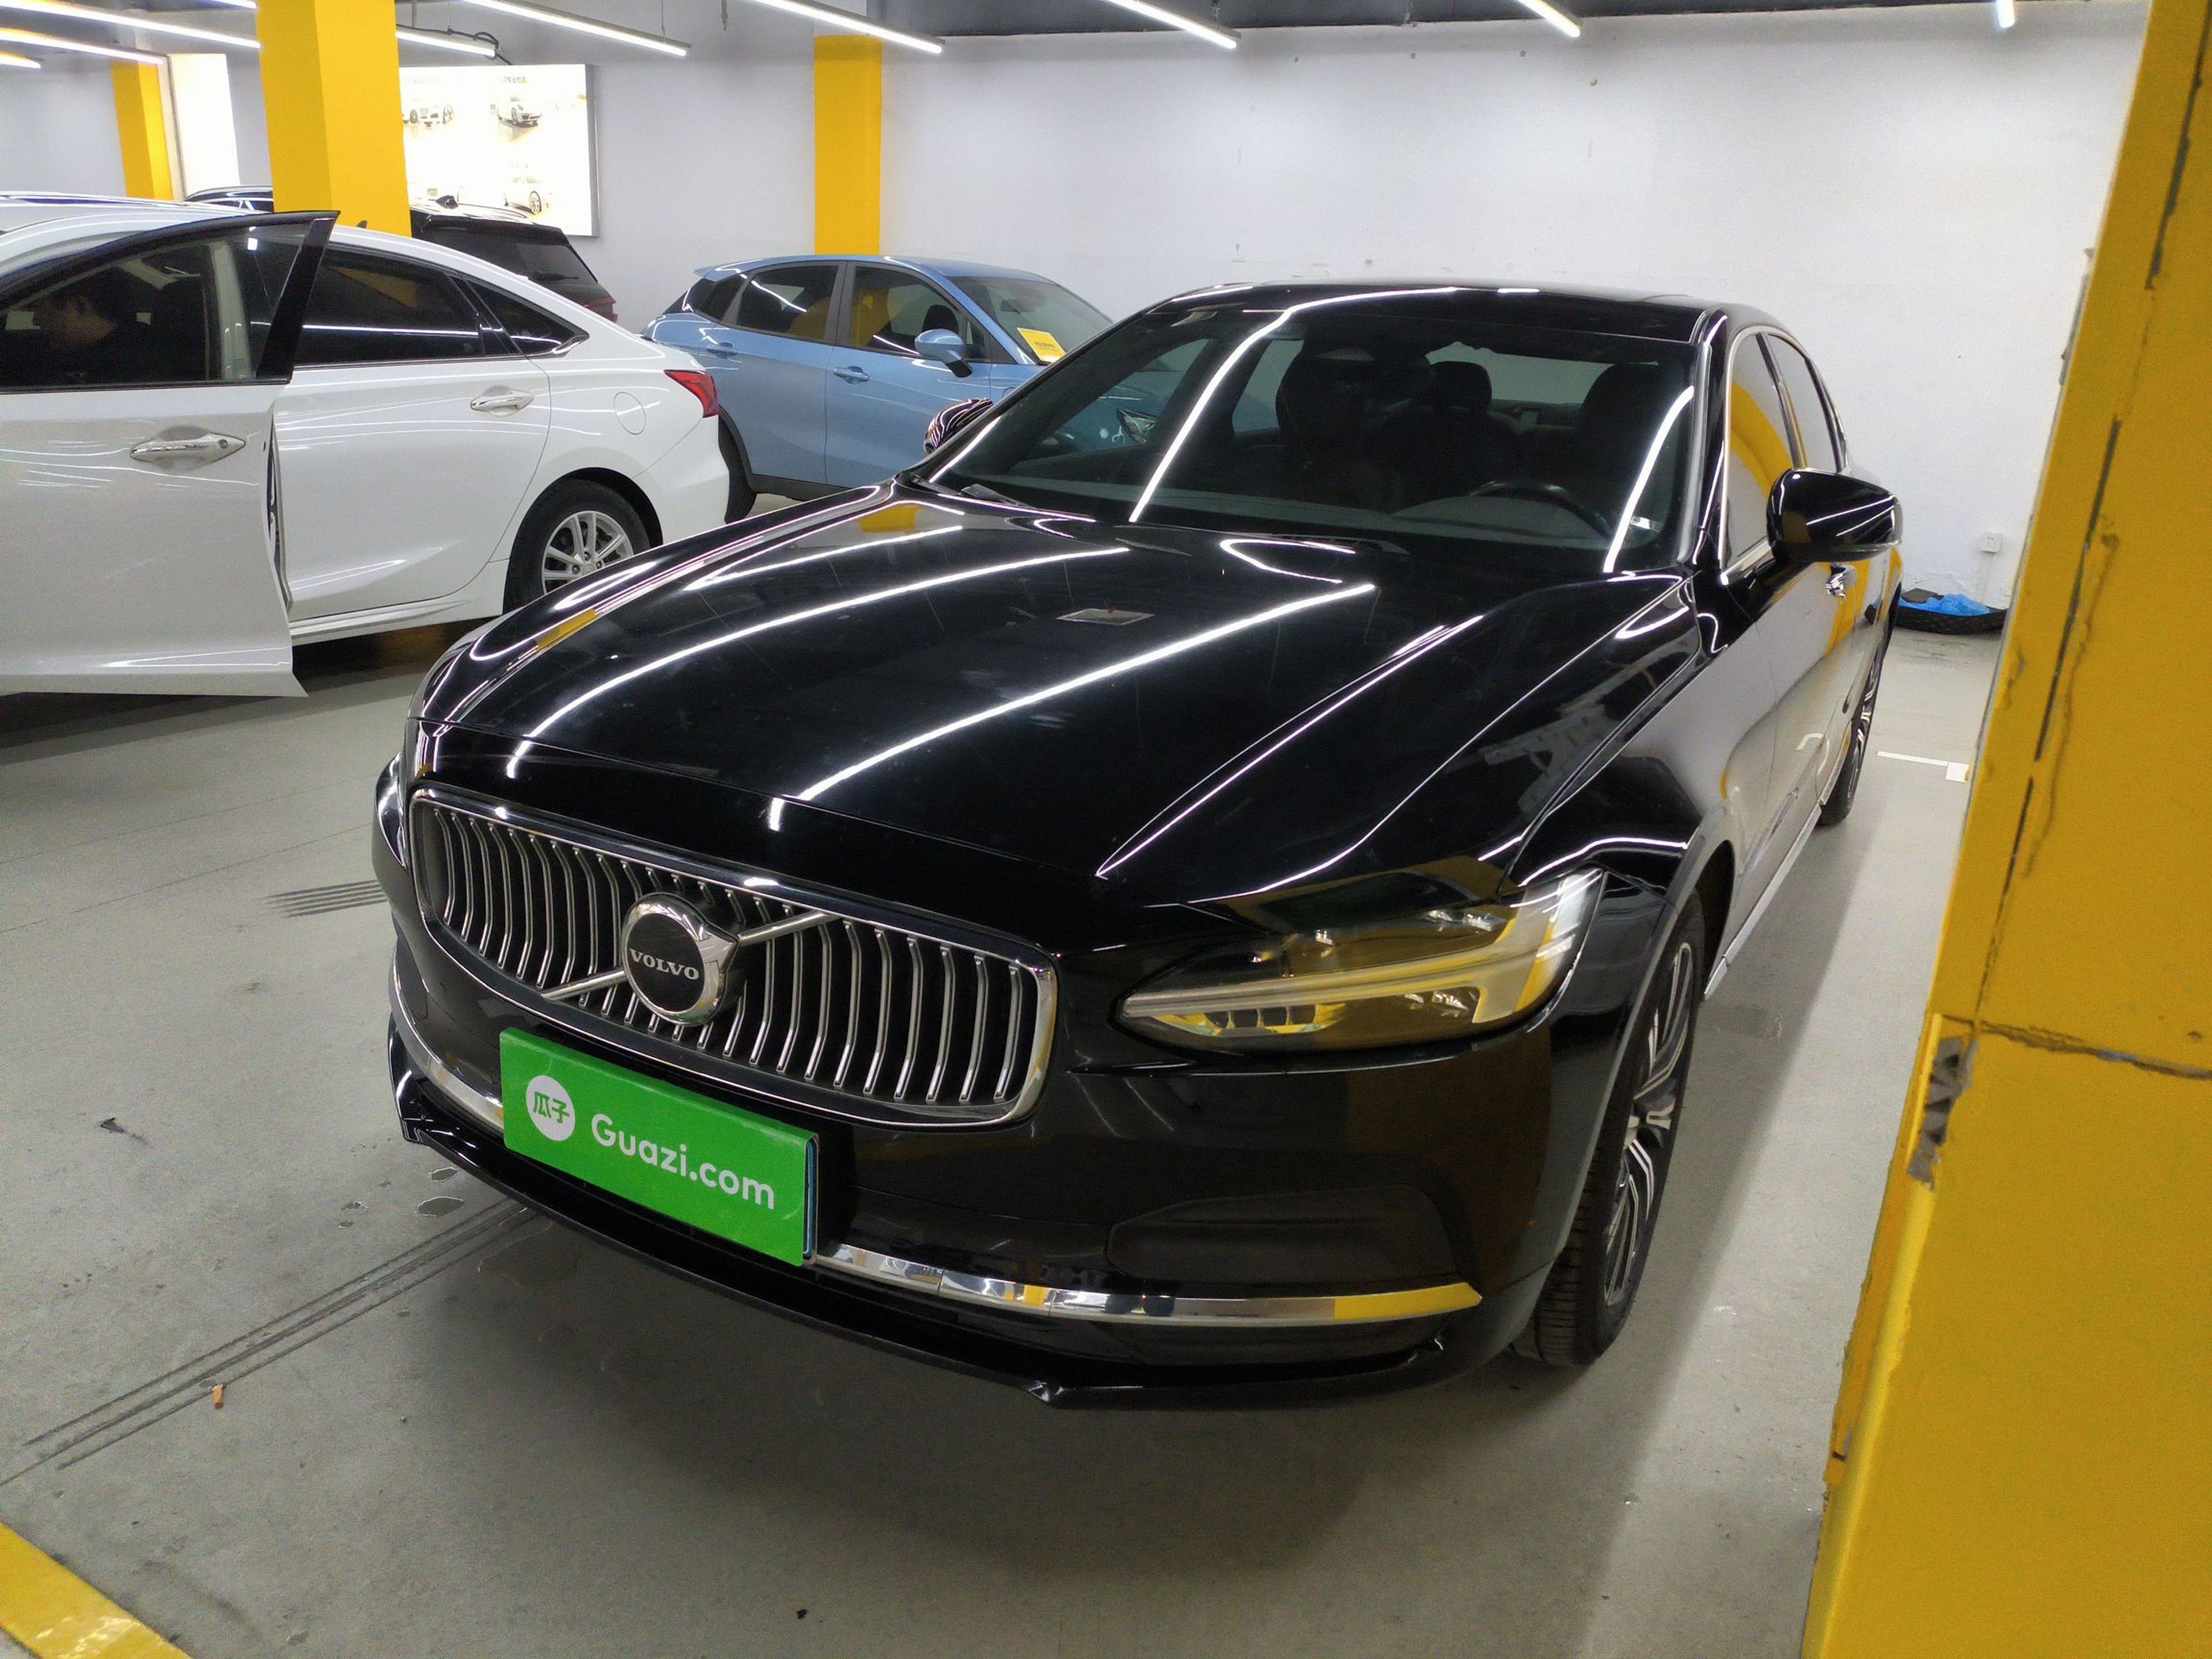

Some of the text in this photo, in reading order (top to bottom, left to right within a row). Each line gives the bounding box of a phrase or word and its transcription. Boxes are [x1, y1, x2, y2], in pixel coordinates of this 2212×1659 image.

[630, 949, 699, 980] VOLVO
[533, 1091, 570, 1124] 瓜子
[591, 1113, 775, 1210] Guazi.com
